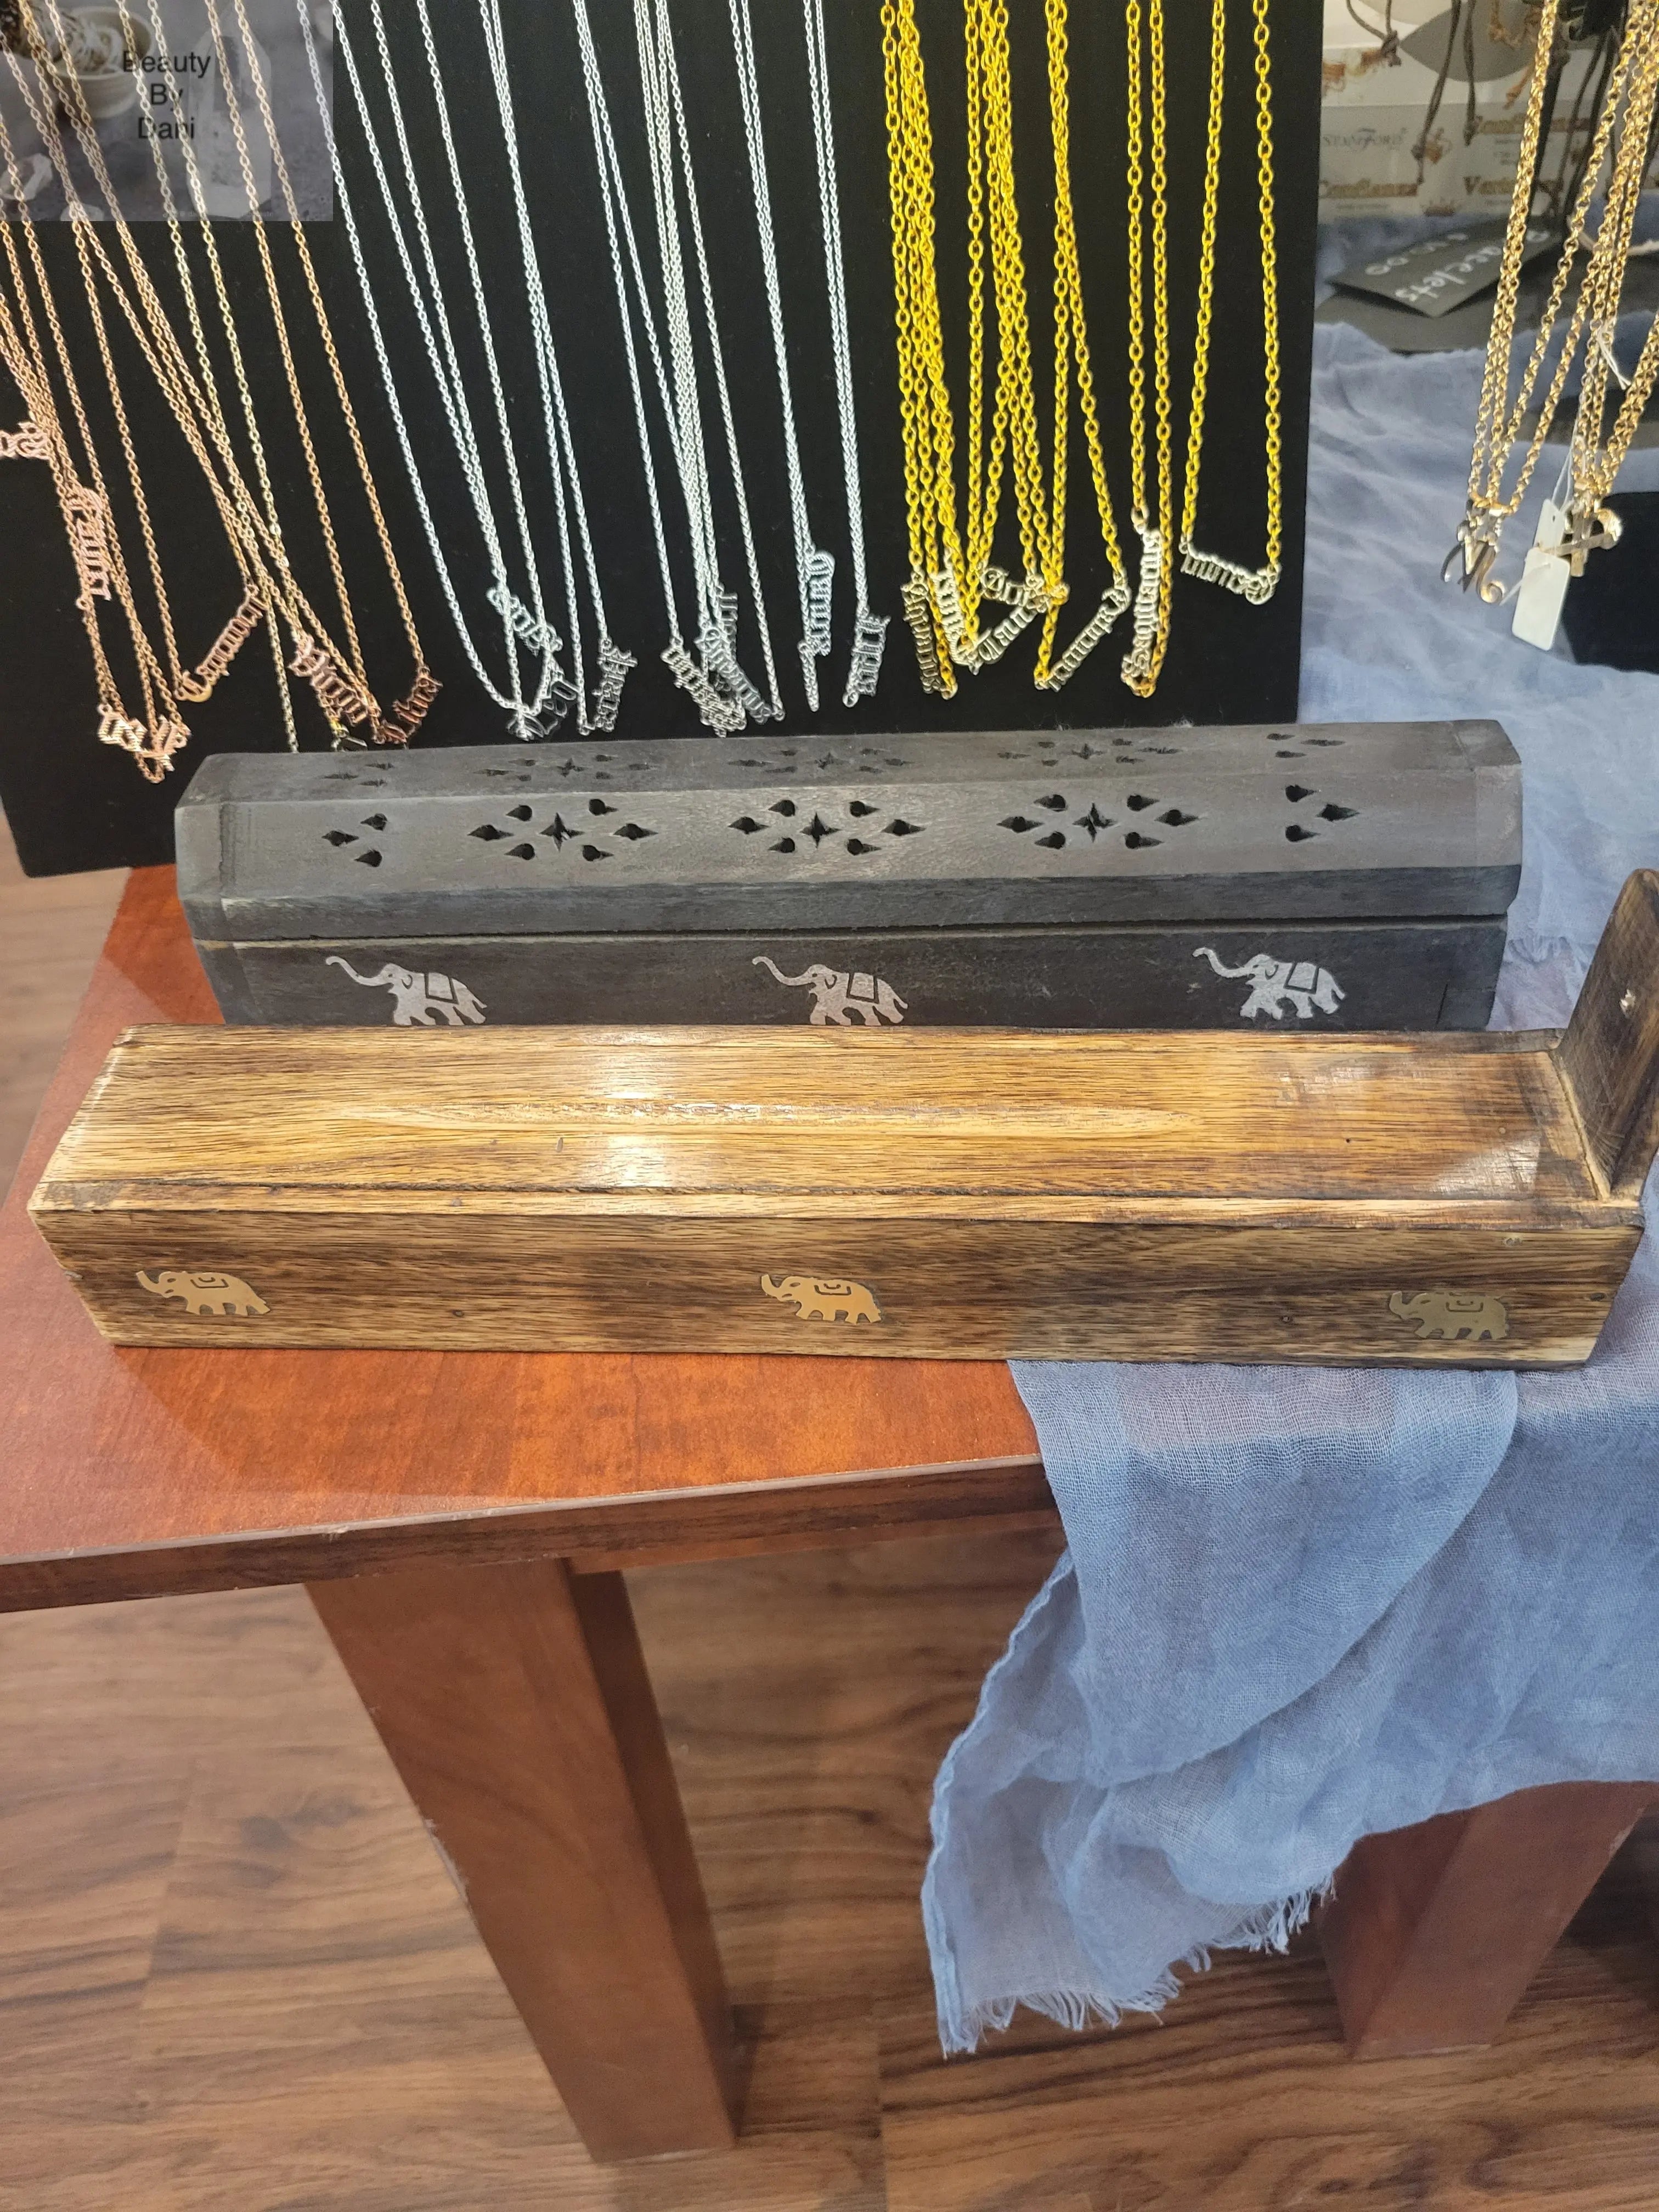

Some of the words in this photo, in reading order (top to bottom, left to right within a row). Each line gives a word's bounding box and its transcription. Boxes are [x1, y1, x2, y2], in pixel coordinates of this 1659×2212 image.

[123, 51, 211, 78] Beauty
[151, 83, 184, 112] By
[139, 116, 195, 139] Dani
[182, 597, 265, 699] Capricorn
[290, 635, 368, 723] Virgo
[379, 672, 443, 743] Libra
